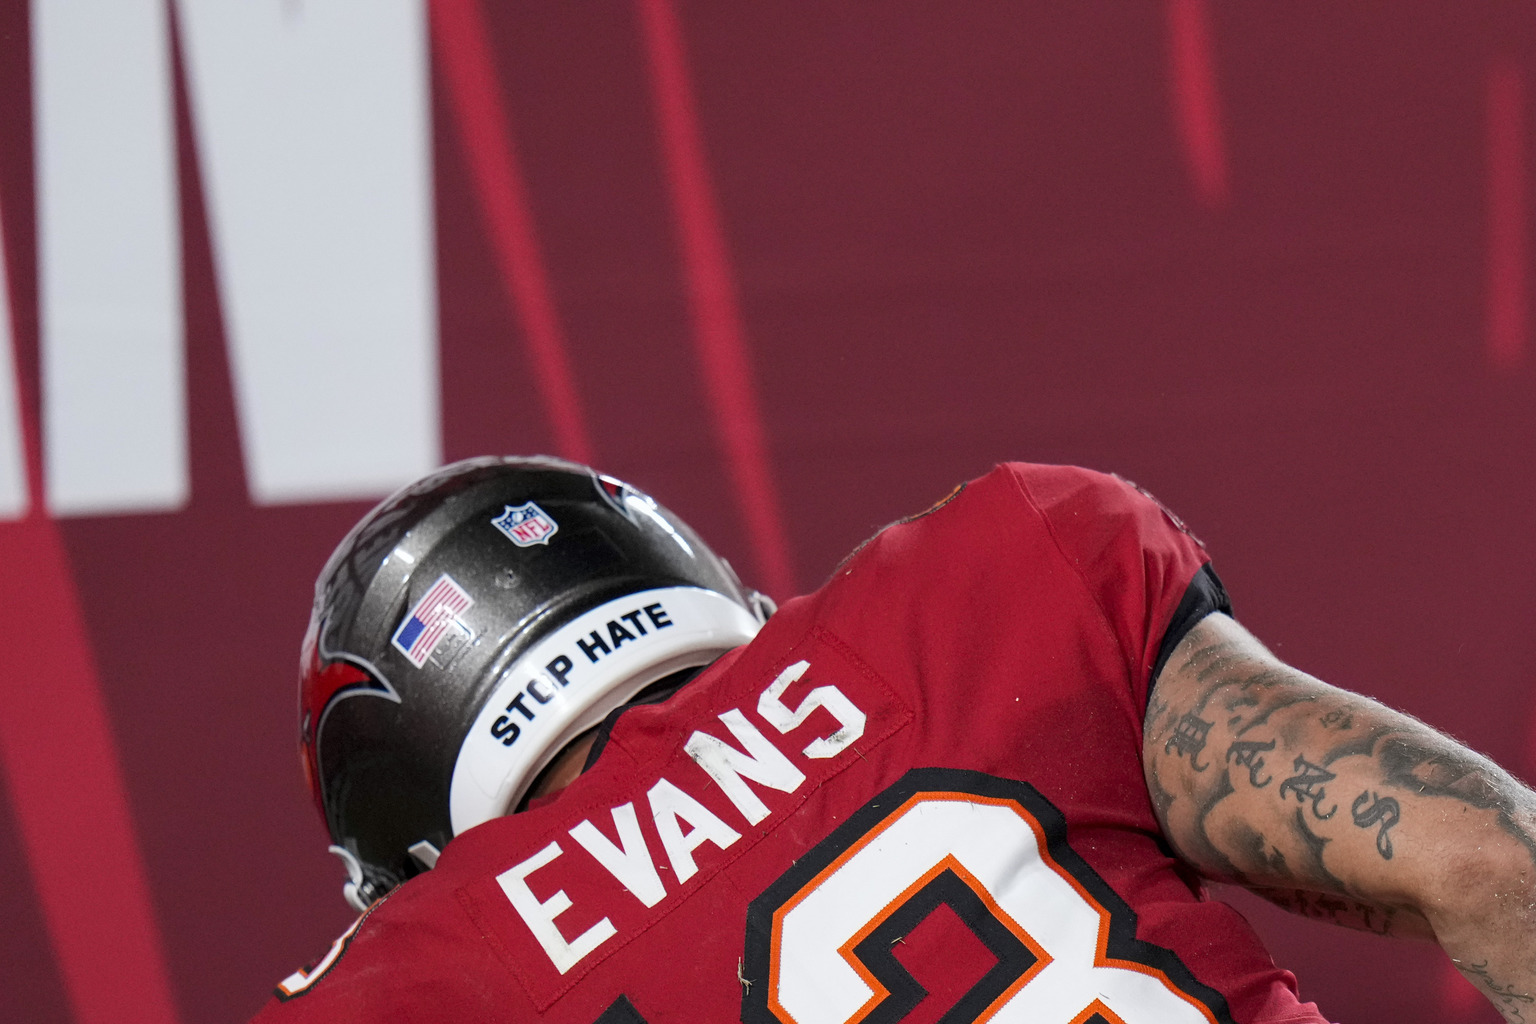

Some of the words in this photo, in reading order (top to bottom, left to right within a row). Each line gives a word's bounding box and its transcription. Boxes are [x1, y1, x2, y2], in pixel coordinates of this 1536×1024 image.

[490, 654, 574, 747] STOP
[576, 602, 674, 664] HATE
[495, 659, 867, 976] EVANS
